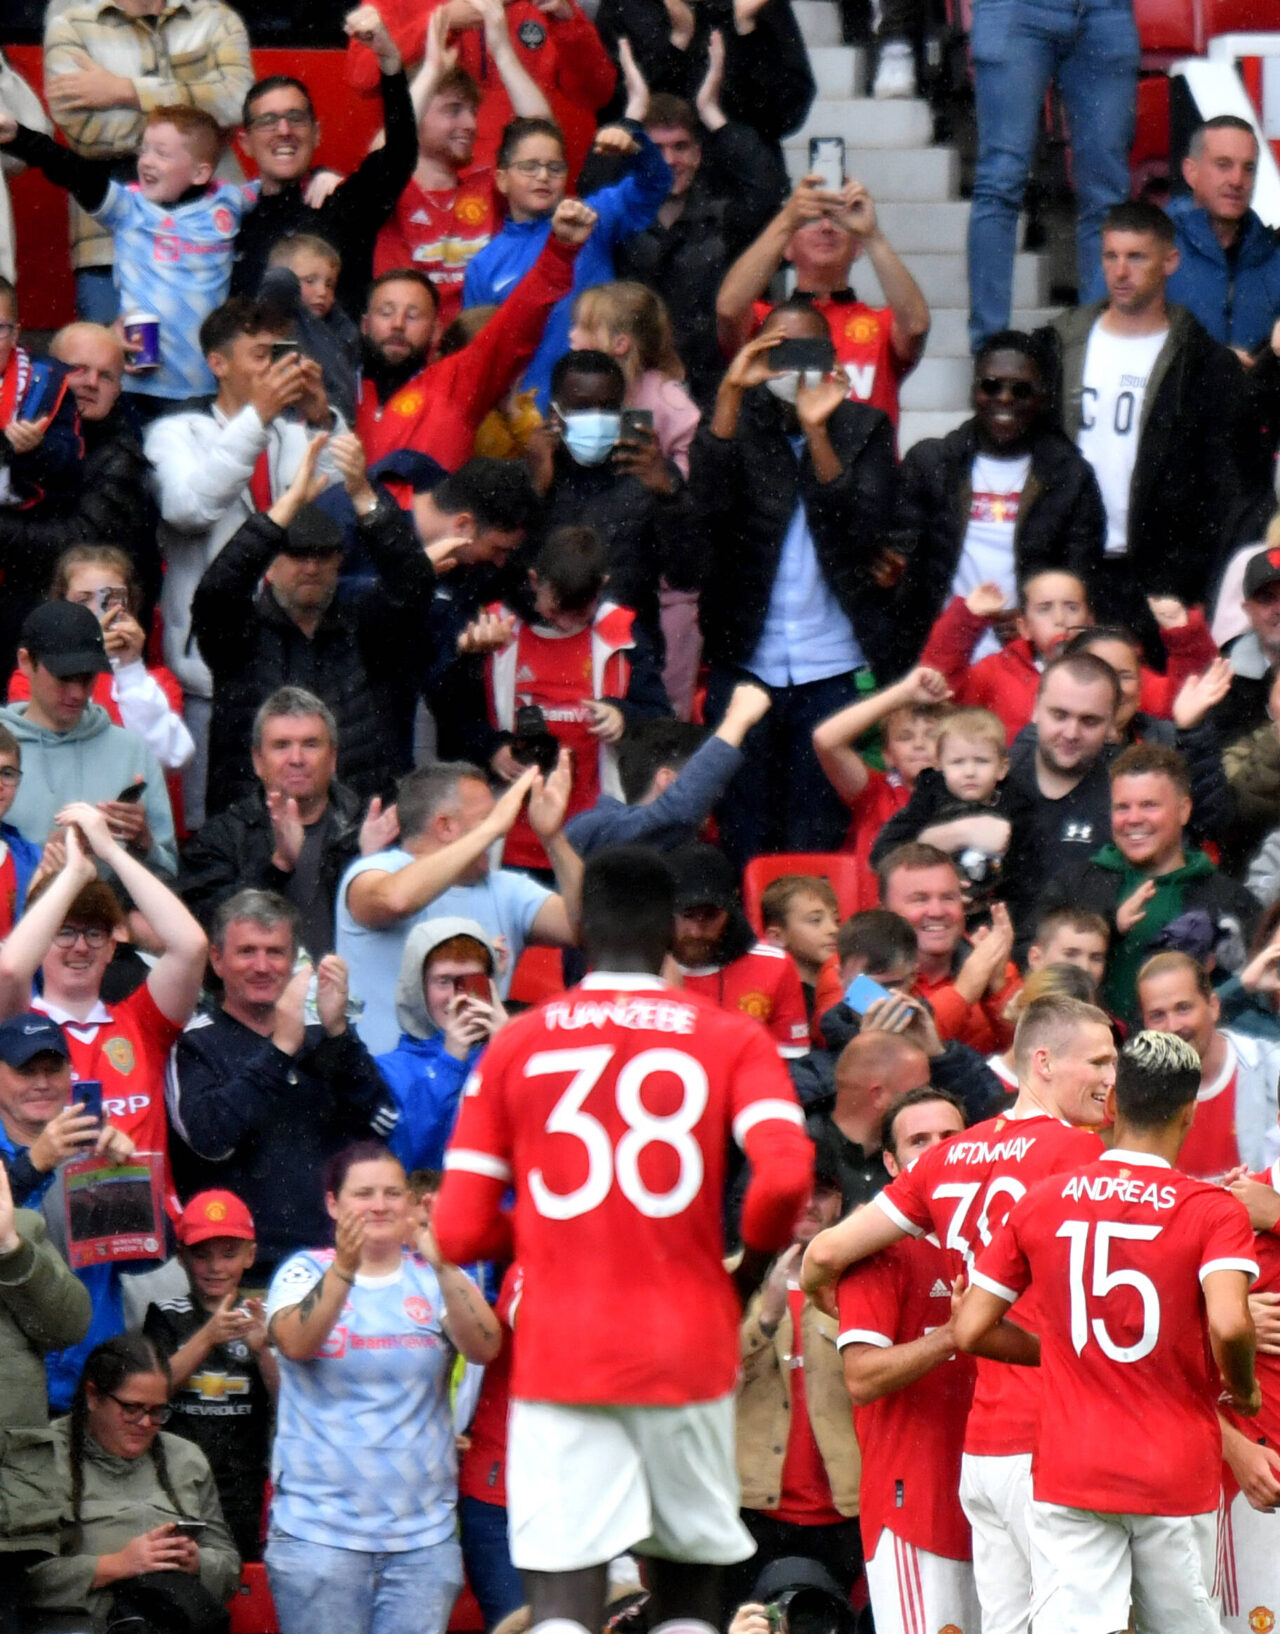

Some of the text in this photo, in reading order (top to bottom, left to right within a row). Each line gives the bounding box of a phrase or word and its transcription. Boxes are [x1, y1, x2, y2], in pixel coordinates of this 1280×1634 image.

[523, 1043, 709, 1221] 38
[1061, 1176, 1177, 1212] ANDREAS
[1055, 1220, 1163, 1363] 15
